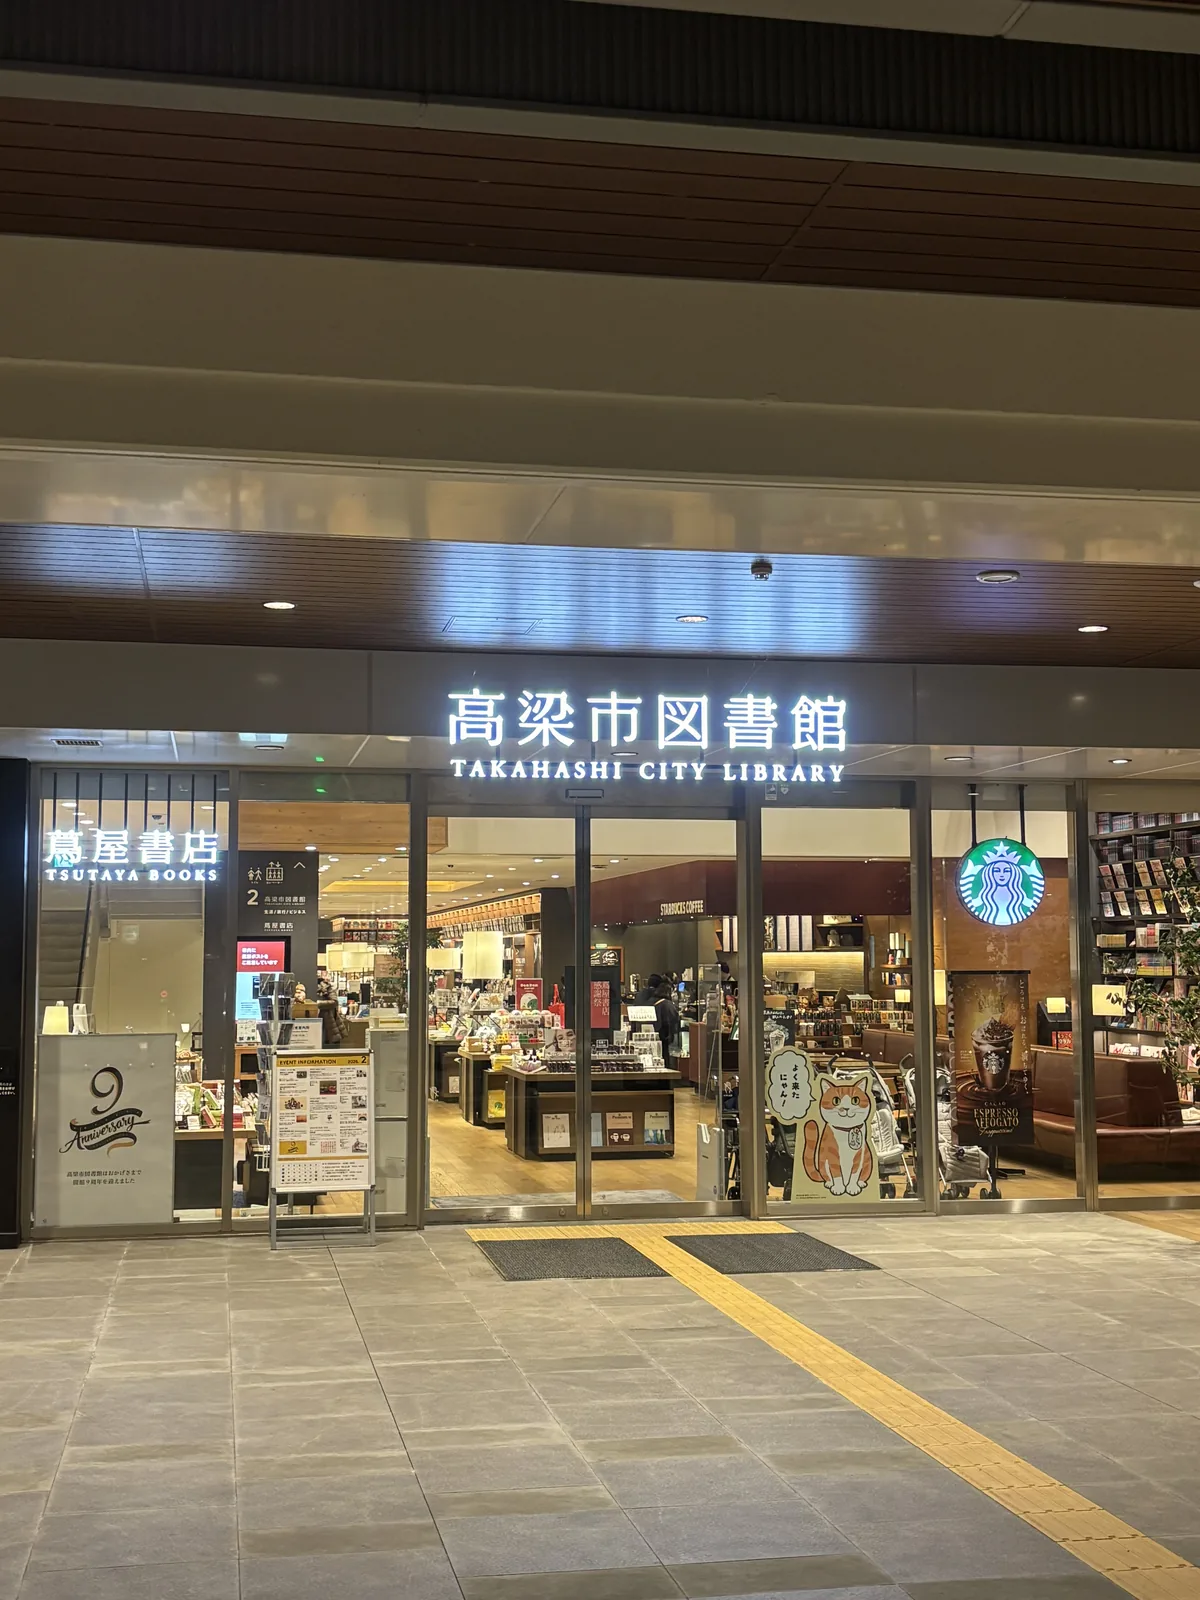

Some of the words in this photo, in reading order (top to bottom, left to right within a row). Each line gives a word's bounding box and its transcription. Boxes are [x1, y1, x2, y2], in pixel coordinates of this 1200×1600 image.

[447, 688, 847, 752] 高梁市図書館
[449, 757, 623, 781] TAKAHASHI
[638, 760, 706, 782] CITY
[723, 762, 847, 784] LIBRARY
[45, 829, 218, 865] 蔦屋書店
[45, 869, 139, 882] TSUTAYA
[148, 869, 218, 882] BOOKS
[247, 889, 258, 906] 2
[660, 901, 686, 916] STARBUCKS
[685, 900, 704, 914] COFFEE
[361, 1055, 367, 1064] 2
[91, 1066, 124, 1115] 9
[791, 1064, 800, 1099] よく来た
[973, 1108, 1019, 1118] ESPRESSO
[975, 1117, 1020, 1128] AFFOGATO
[59, 1115, 151, 1153] Anniversary
